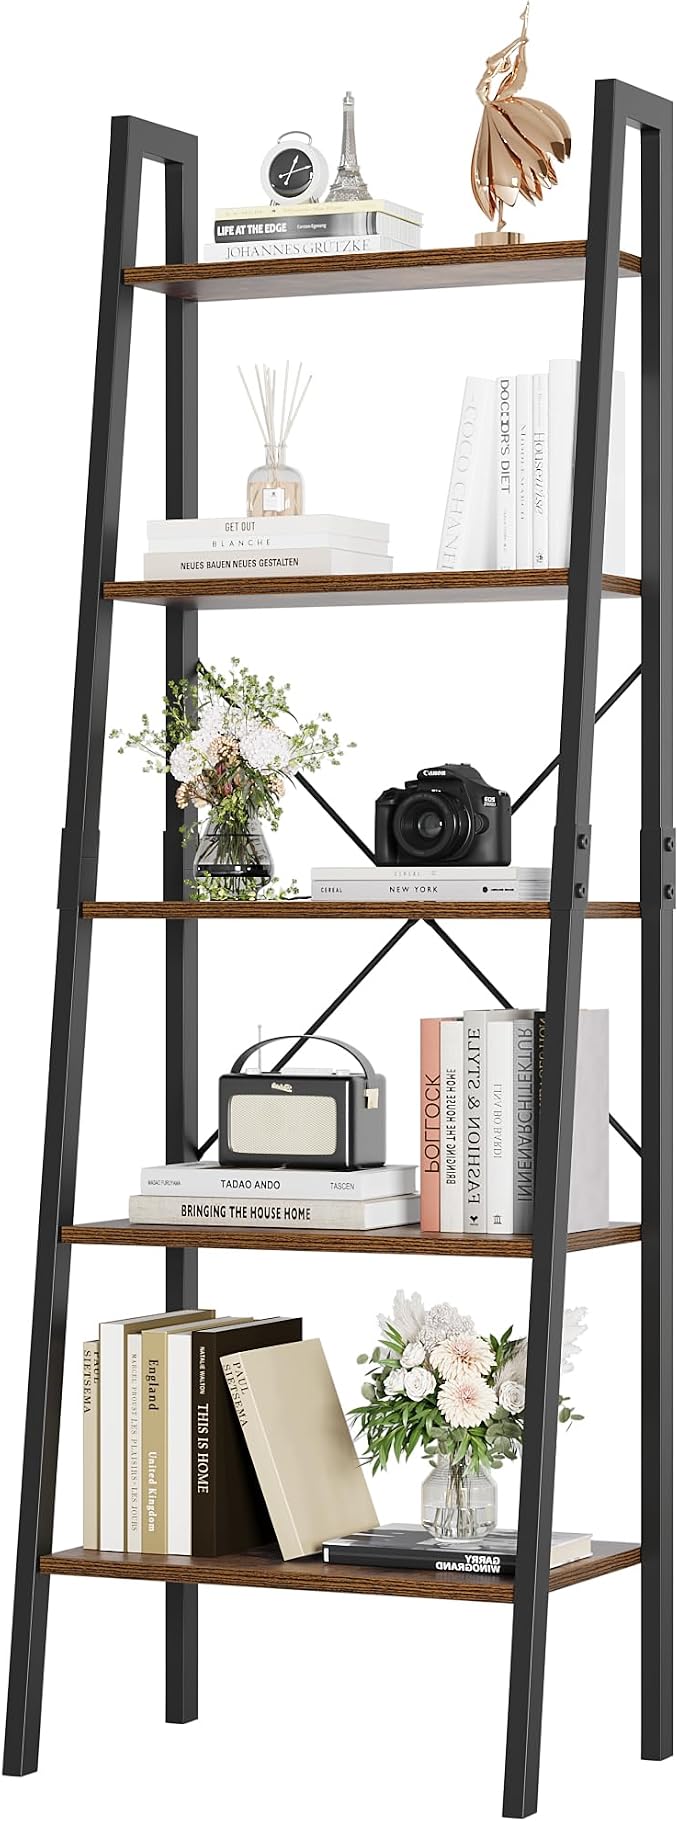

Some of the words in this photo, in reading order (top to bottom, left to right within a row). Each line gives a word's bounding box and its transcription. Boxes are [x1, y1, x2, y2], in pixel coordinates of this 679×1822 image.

[217, 225, 234, 236] LIFE
[235, 225, 245, 235] AT
[247, 223, 263, 235] THE
[264, 222, 287, 233] EDGE
[225, 242, 300, 259] JOHANNES
[501, 460, 510, 494] DIET
[225, 522, 239, 532] GET
[241, 521, 256, 532] OUT
[212, 538, 271, 548] BLANCHE
[180, 561, 204, 570] NEUES
[206, 560, 231, 569] BAUEN
[232, 559, 257, 568] NEUES
[258, 557, 299, 568] GESTALTEN
[220, 1179, 252, 1189] TADAO
[254, 1180, 281, 1190] ANDO
[181, 1204, 226, 1218] BRINGING
[230, 1205, 248, 1219] THE
[250, 1206, 281, 1220] HOUSE
[284, 1207, 311, 1220] HOME
[83, 1350, 91, 1413] SIETSEMA
[146, 1359, 159, 1411] England
[233, 1362, 249, 1395] PAUL
[224, 1364, 248, 1427] SIETSEMA
[197, 1403, 209, 1434] THIS
[197, 1437, 209, 1449] IS
[147, 1451, 157, 1485] United
[197, 1453, 209, 1494] HOME
[145, 1488, 157, 1532] Kingdom
